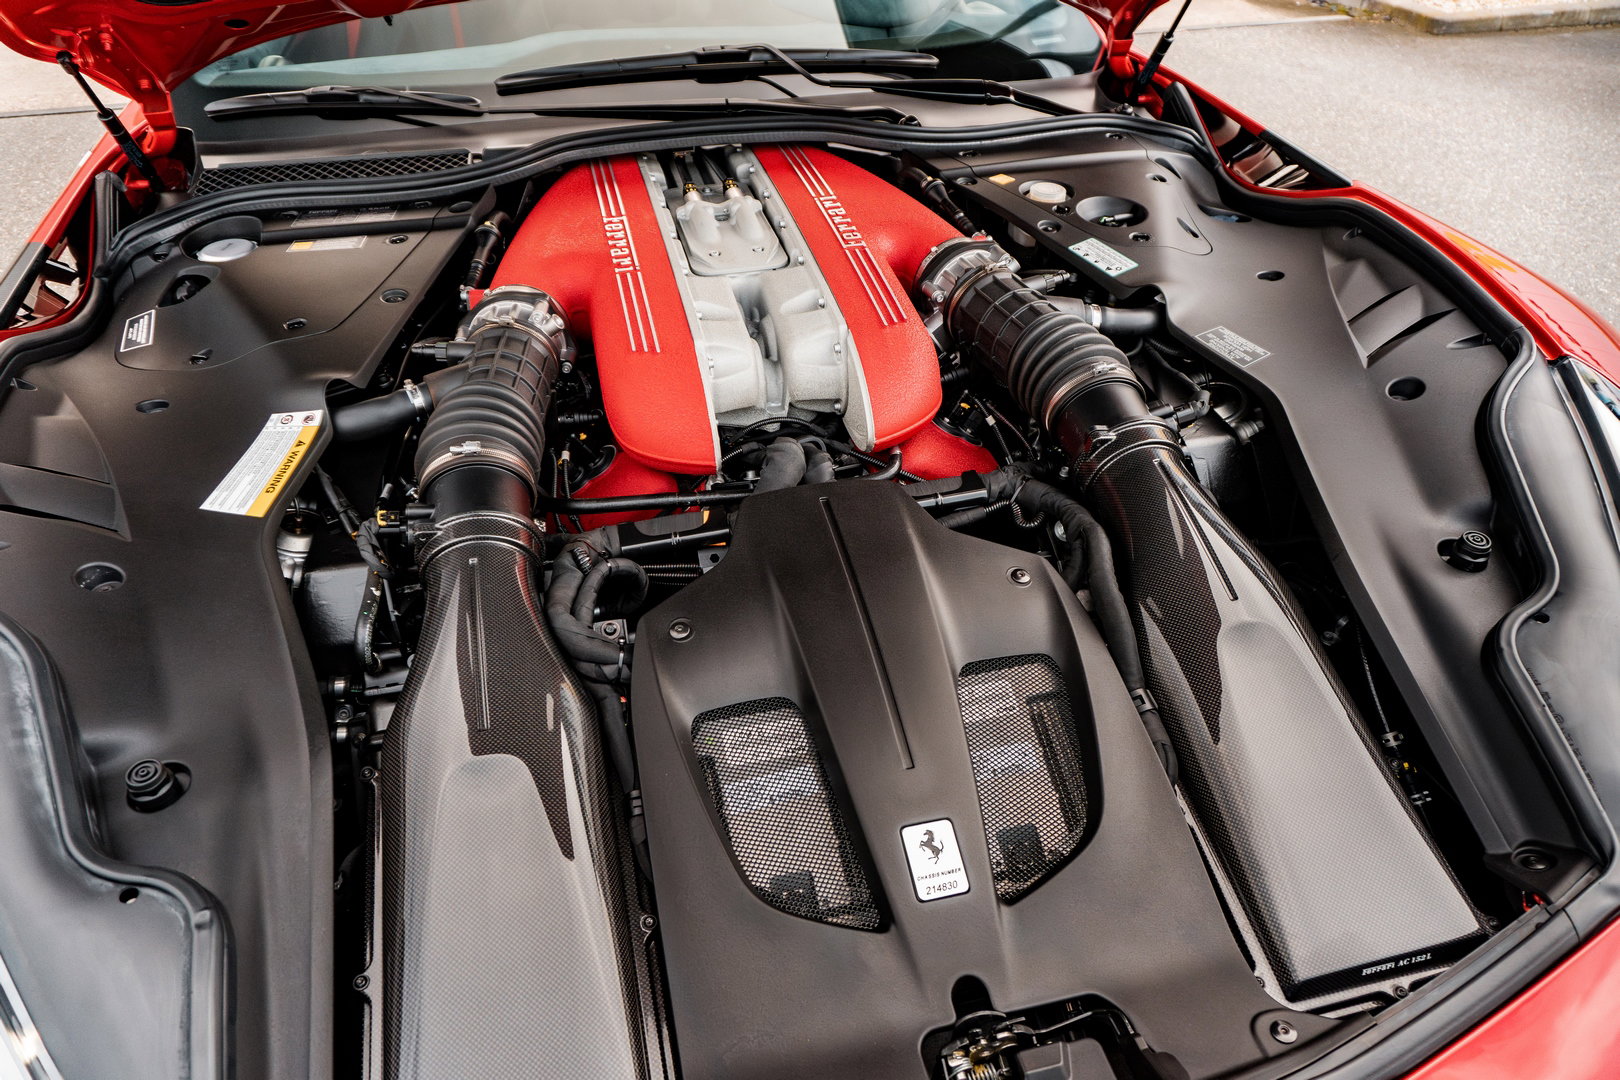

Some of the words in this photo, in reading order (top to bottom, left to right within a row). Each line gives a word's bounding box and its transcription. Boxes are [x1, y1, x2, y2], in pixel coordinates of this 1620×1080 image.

[265, 450, 300, 494] WARNING
[917, 872, 940, 881] CHASSIS
[941, 867, 961, 876] NUMBER
[926, 880, 958, 895] 214830
[1362, 962, 1395, 976] Ferrari
[1397, 958, 1410, 966] AC
